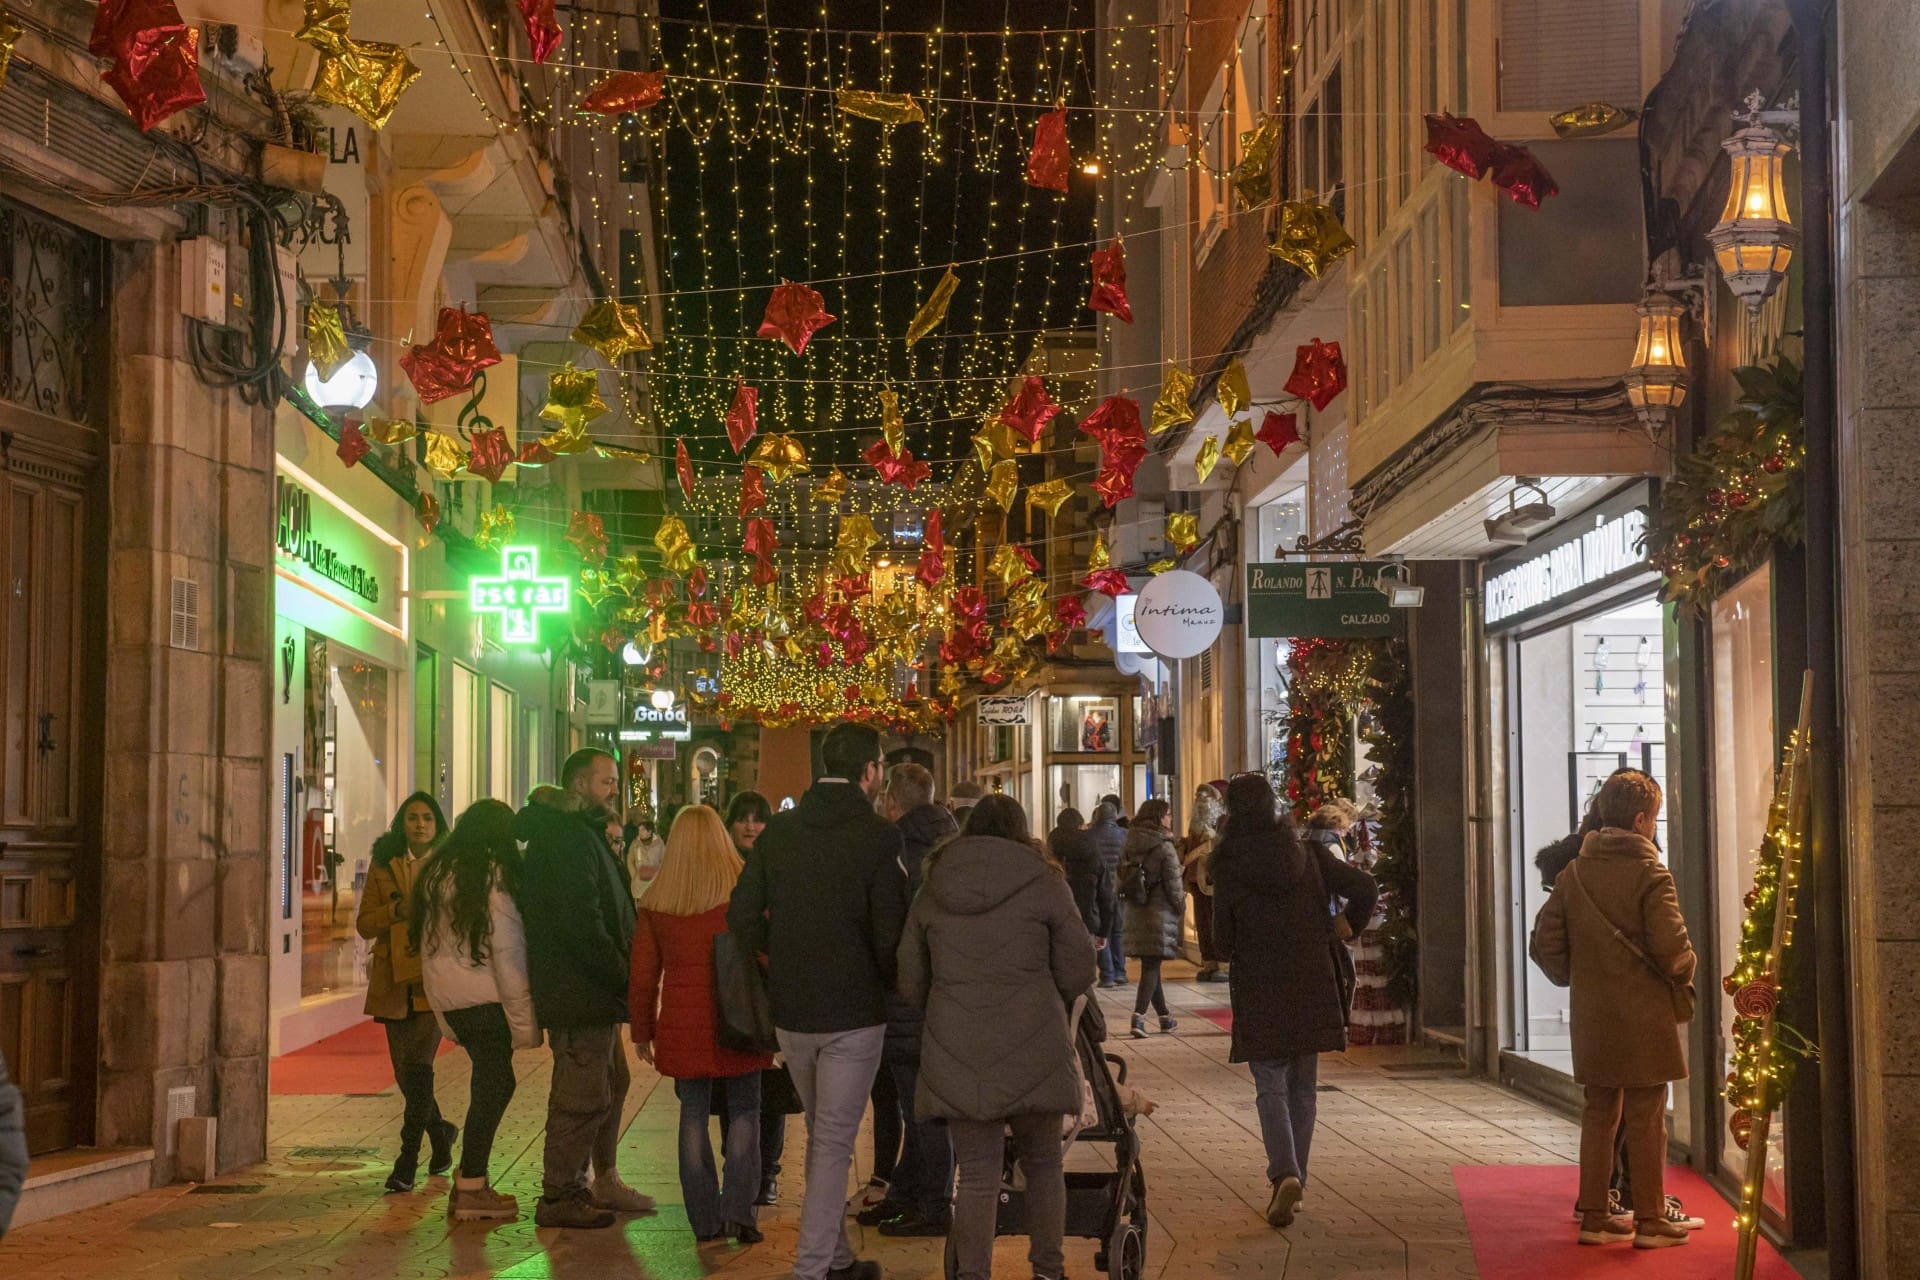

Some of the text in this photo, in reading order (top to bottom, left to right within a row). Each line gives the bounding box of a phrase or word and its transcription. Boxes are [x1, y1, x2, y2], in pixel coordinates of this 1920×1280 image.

[1252, 568, 1303, 589] ROLANDO
[1335, 576, 1346, 588] N.
[1485, 553, 1552, 625] ACCESORIOS
[1550, 538, 1584, 598] PARA
[1340, 614, 1391, 625] CALZADO
